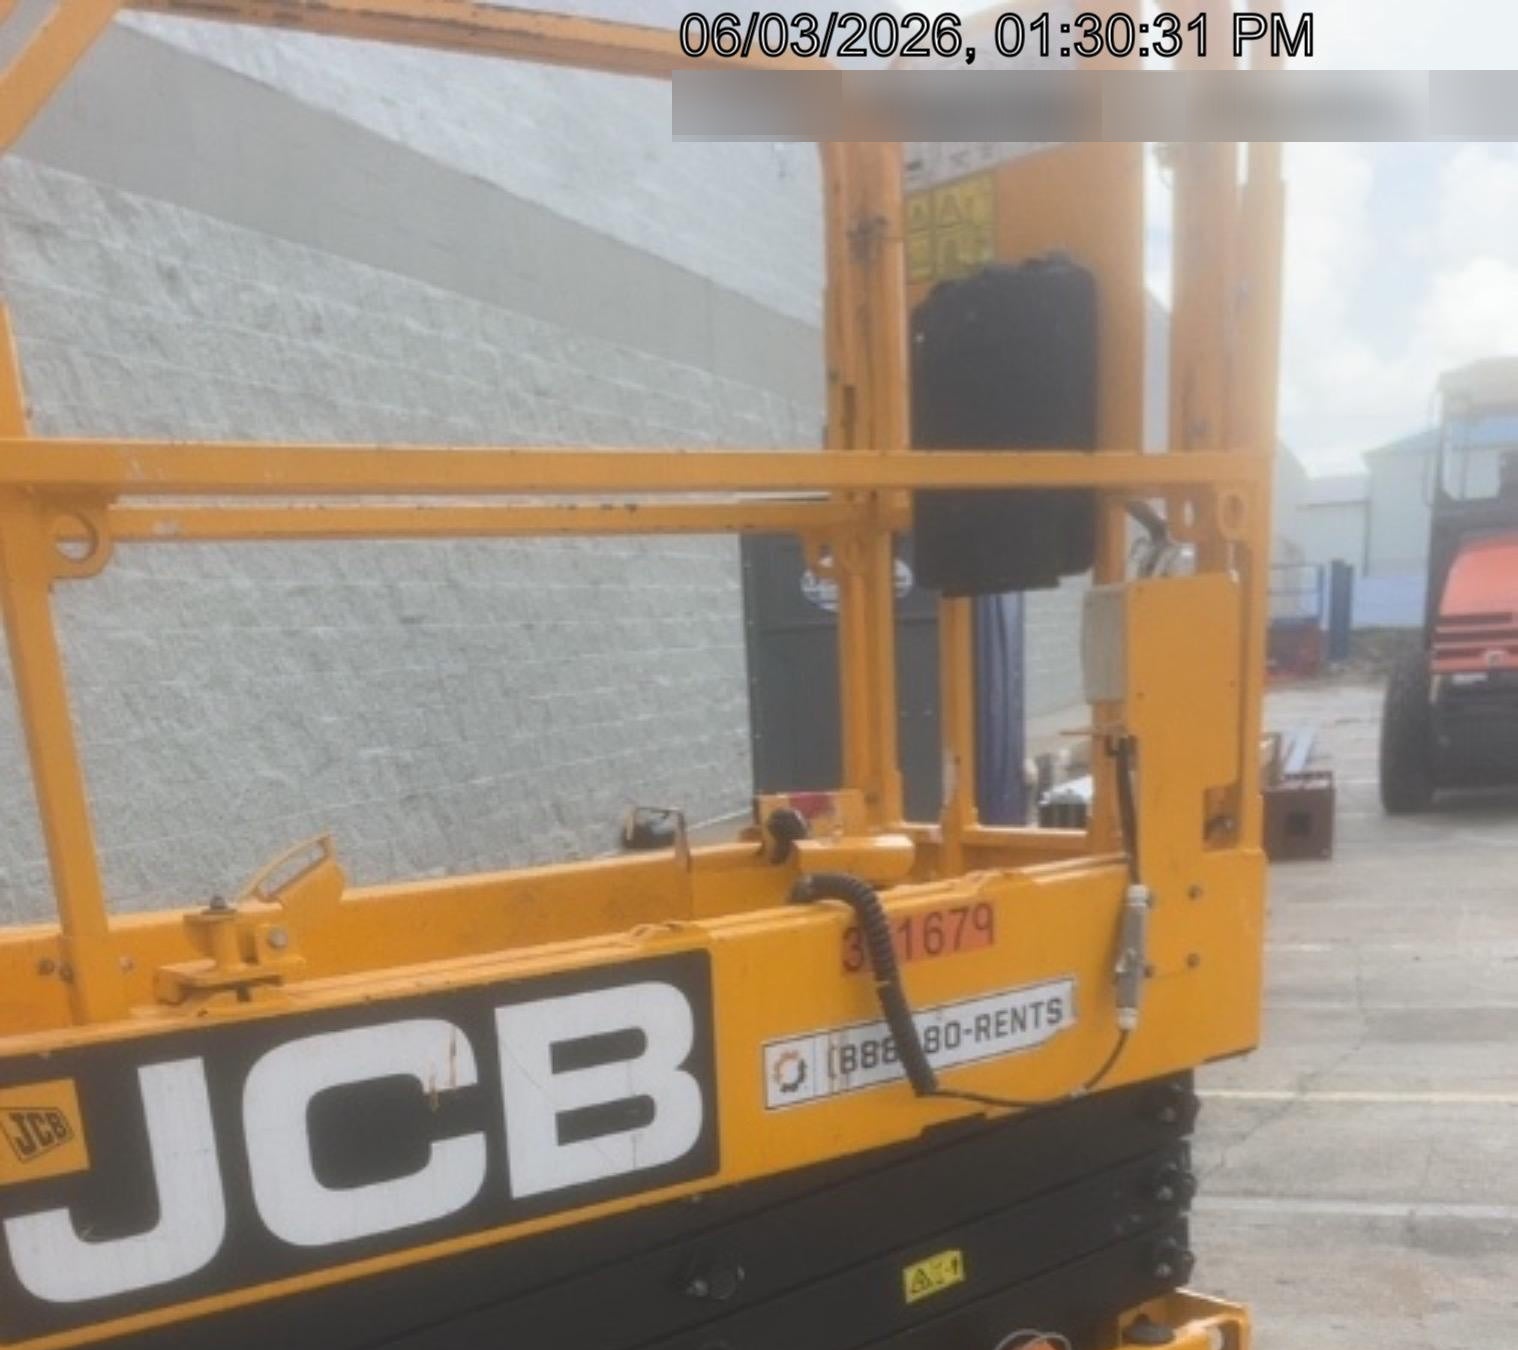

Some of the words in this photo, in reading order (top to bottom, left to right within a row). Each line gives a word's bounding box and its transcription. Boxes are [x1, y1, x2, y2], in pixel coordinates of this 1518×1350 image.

[841, 903, 995, 973] 31679
[922, 998, 1063, 1054] 80-RENTS
[3, 981, 703, 1303] JCB
[8, 1111, 67, 1156] JCB
